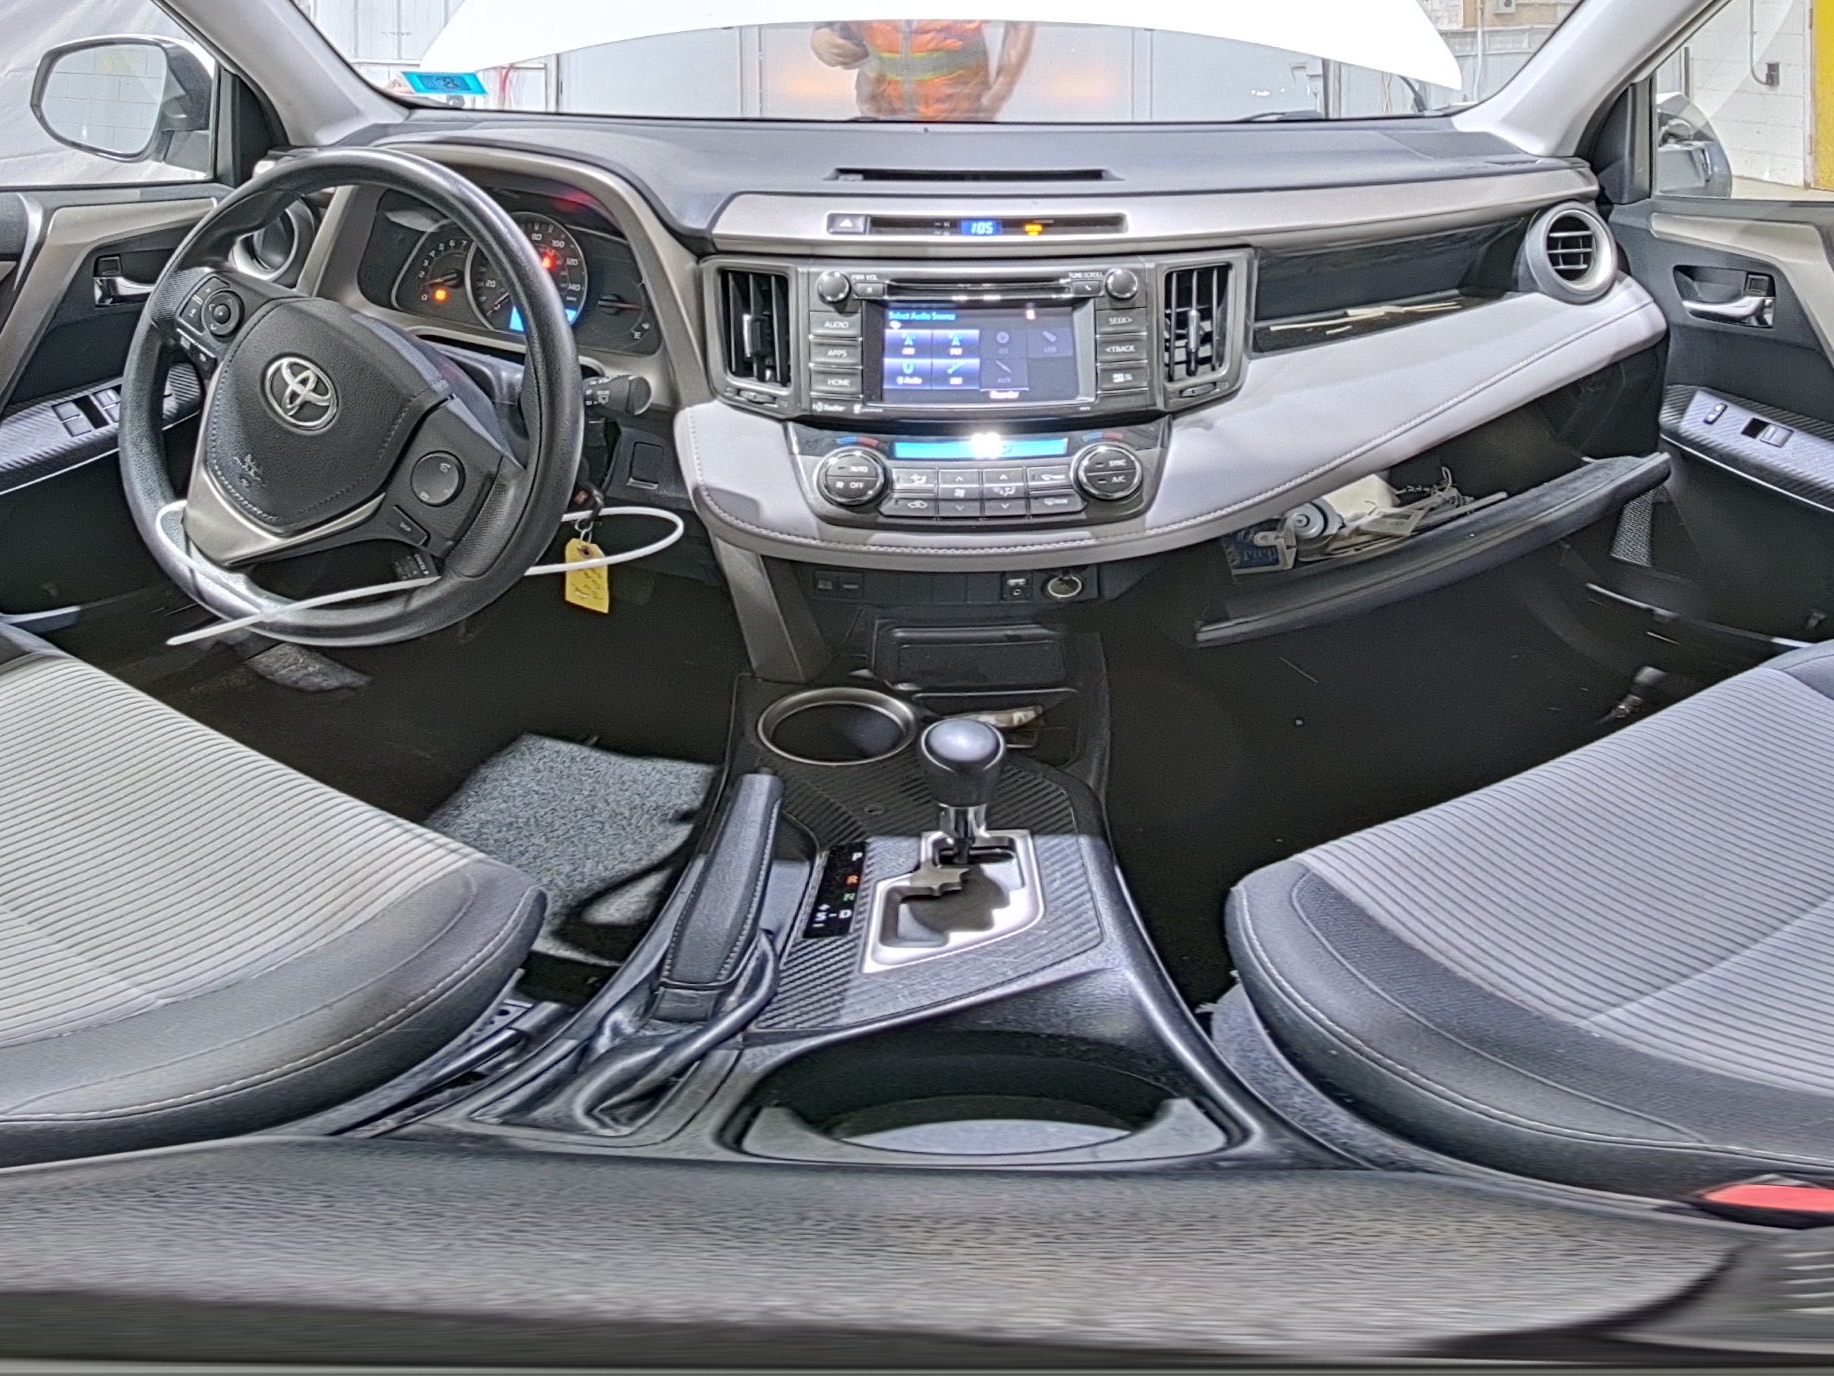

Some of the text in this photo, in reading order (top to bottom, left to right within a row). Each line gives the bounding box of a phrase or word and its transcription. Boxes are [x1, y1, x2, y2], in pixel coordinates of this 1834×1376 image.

[824, 320, 849, 329] AUDIO
[827, 349, 848, 357] APPS
[827, 378, 851, 386] HOME
[851, 852, 864, 861] P
[843, 893, 856, 901] N
